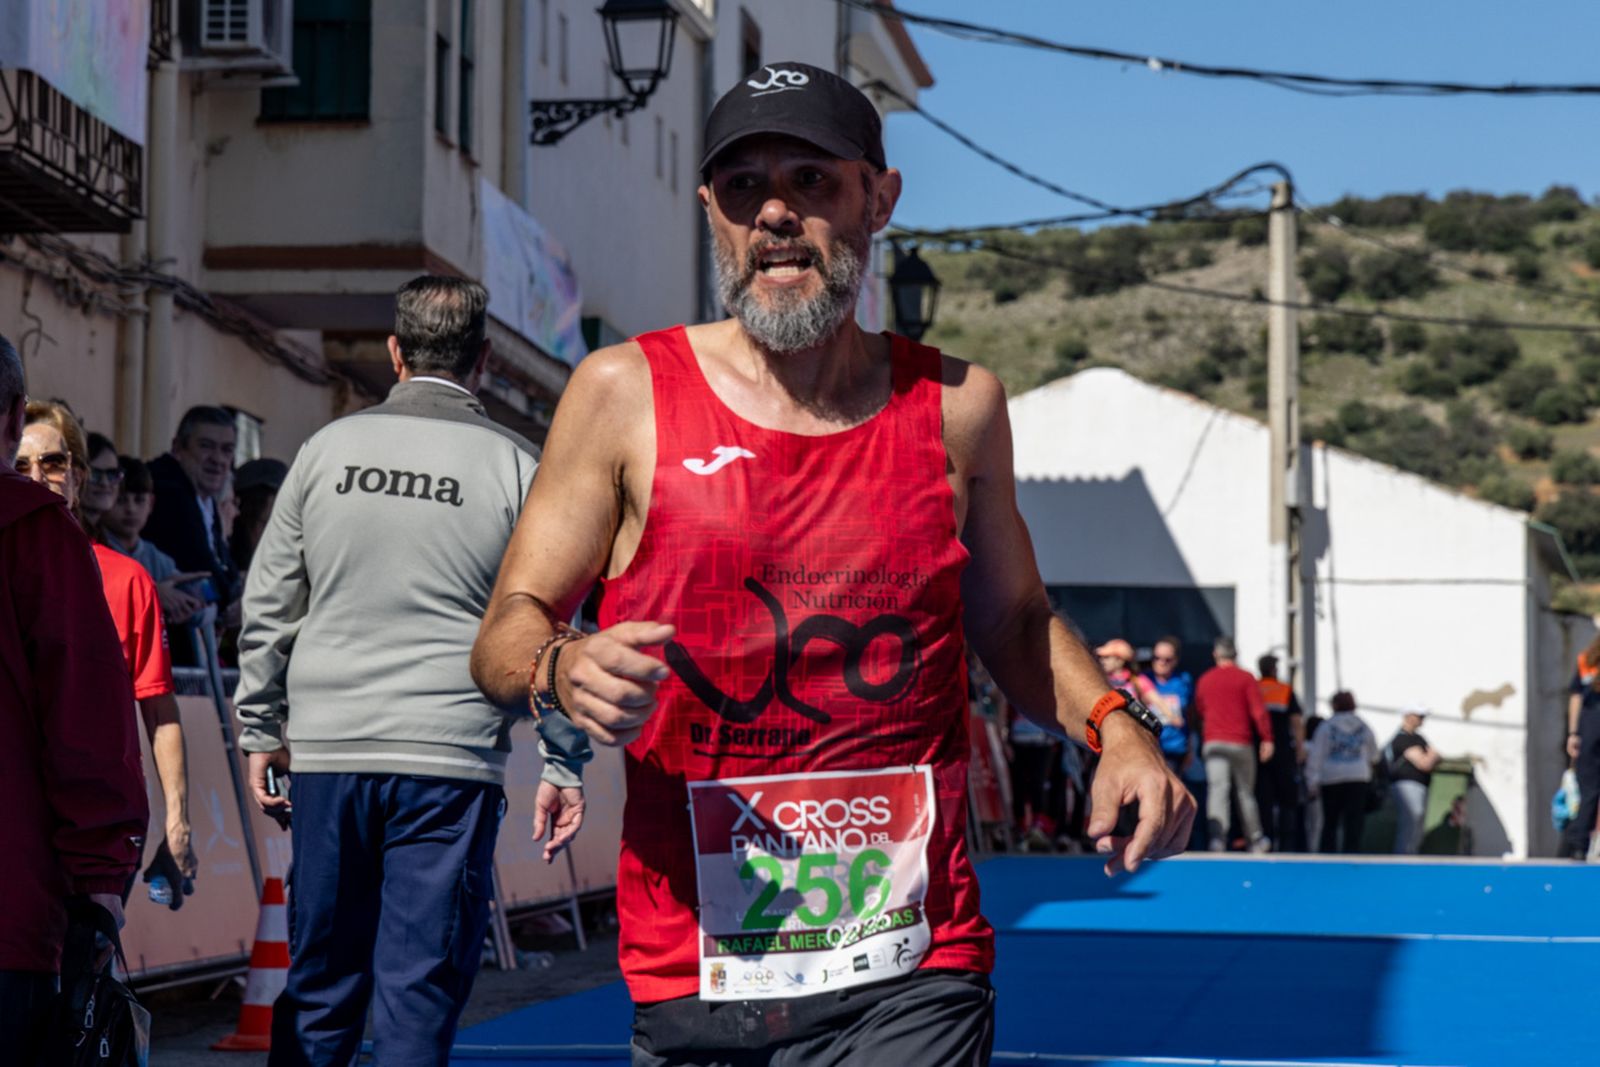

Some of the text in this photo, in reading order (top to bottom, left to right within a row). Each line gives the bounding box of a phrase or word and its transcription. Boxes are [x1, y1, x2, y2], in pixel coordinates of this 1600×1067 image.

[336, 466, 463, 507] Joma
[761, 564, 931, 589] Endocrinología
[793, 590, 900, 609] Nutrición
[719, 724, 811, 747] Serrano
[727, 791, 766, 831] X
[772, 796, 892, 831] CROSS
[731, 828, 867, 861] PANTANO
[739, 848, 892, 930] 256
[717, 934, 786, 954] RAFAEL
